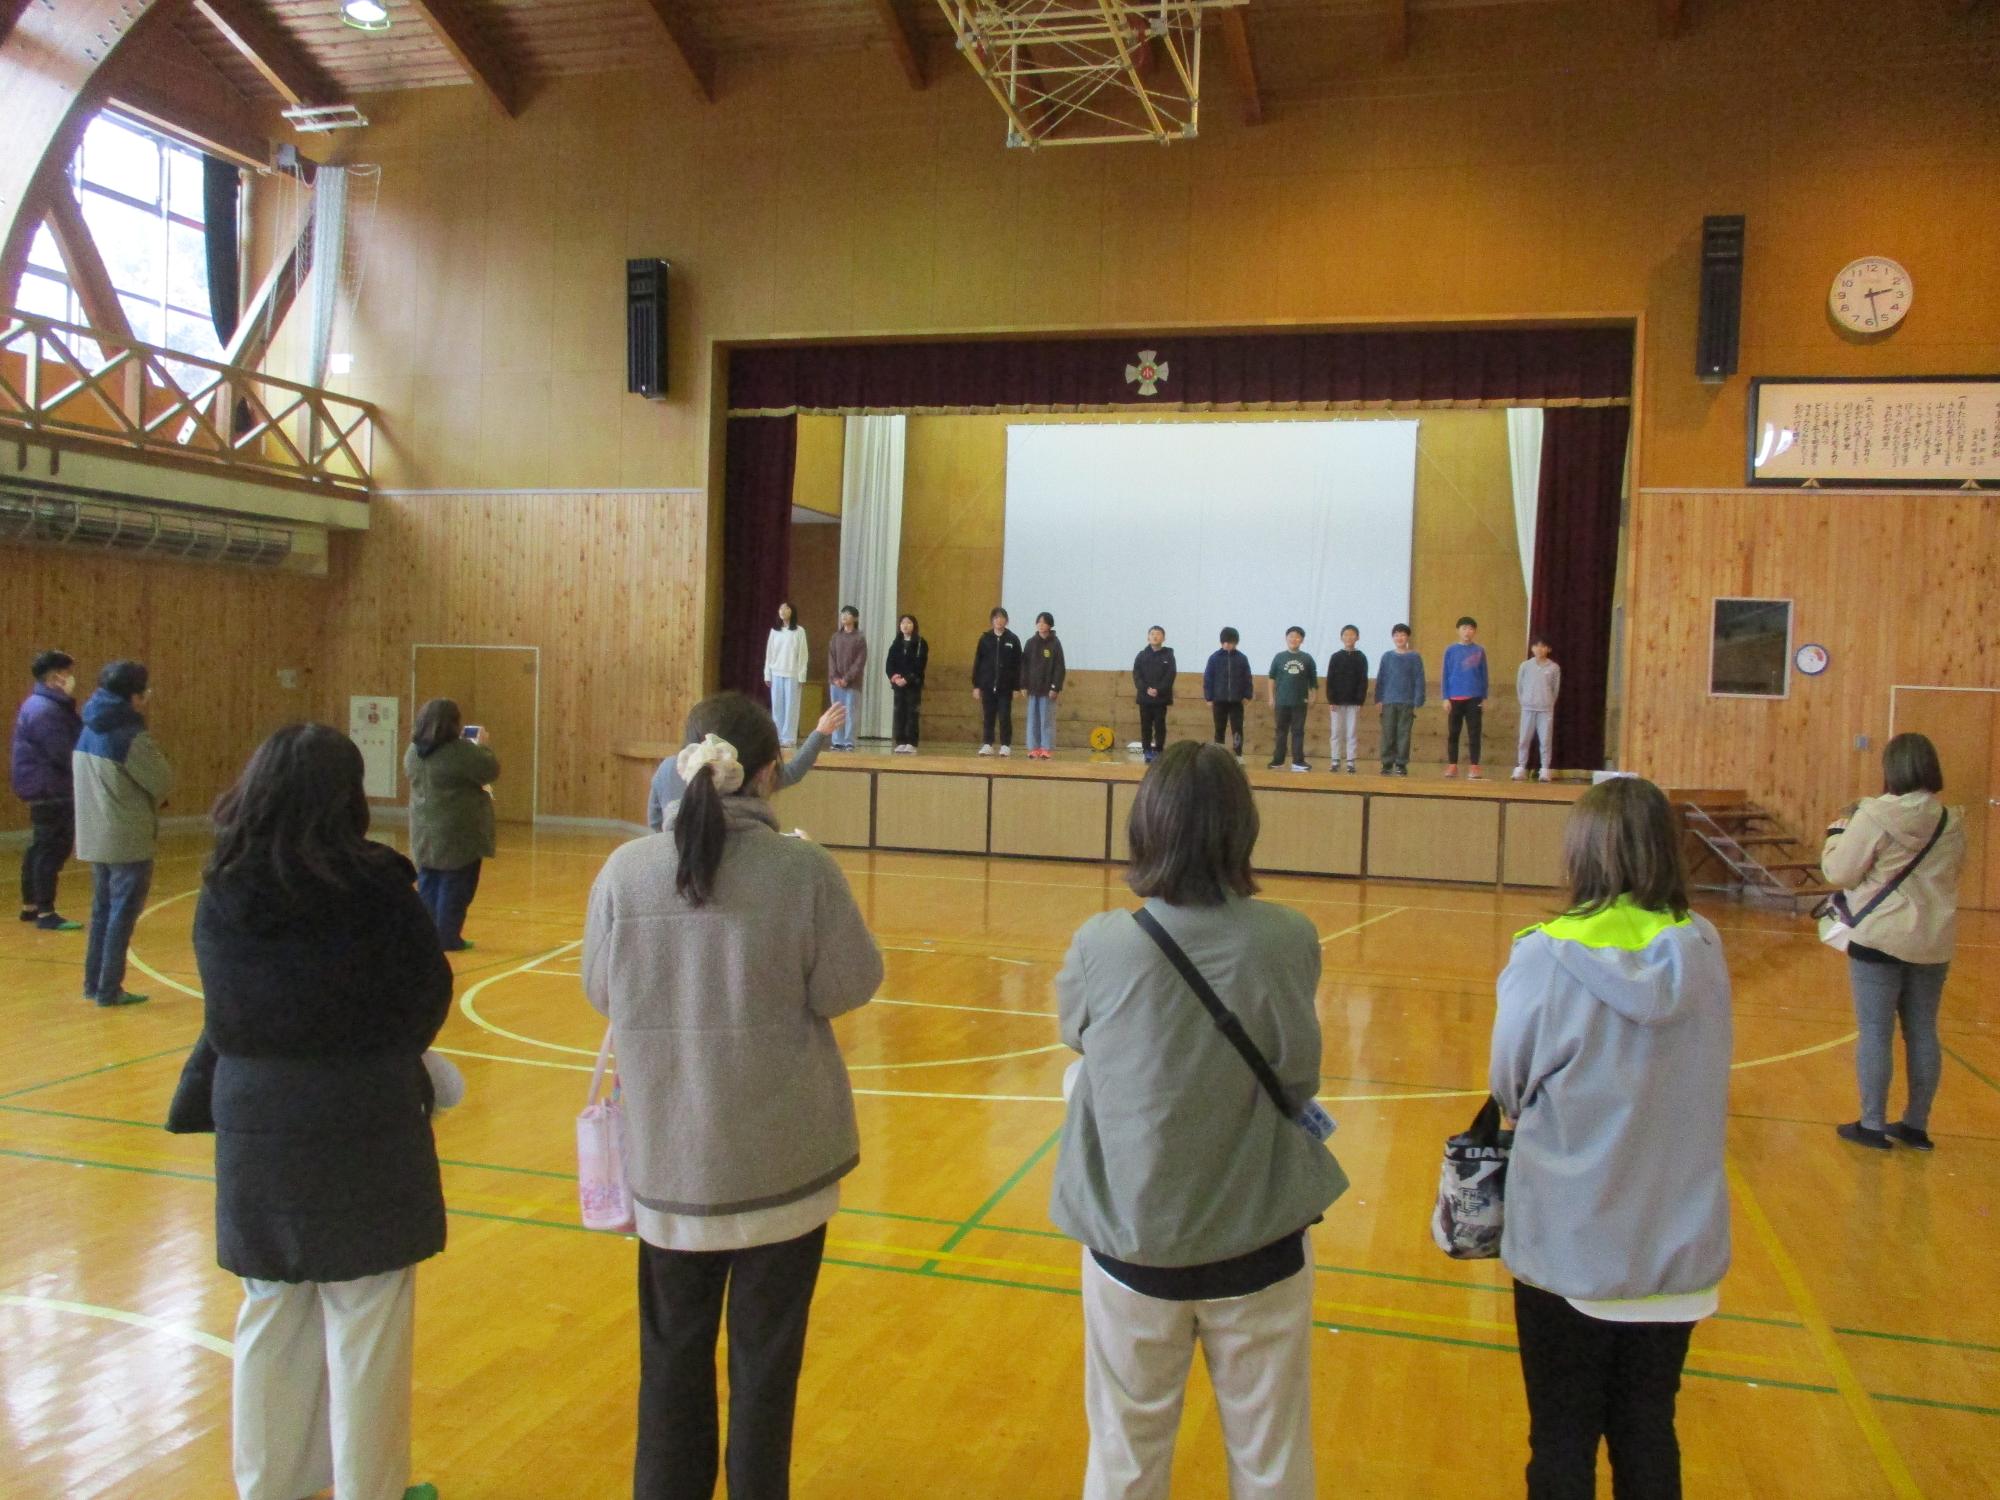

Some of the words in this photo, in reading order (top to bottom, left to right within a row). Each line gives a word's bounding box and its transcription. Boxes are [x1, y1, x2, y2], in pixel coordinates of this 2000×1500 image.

[1866, 264, 1878, 272] 12
[1892, 277, 1901, 285] 2
[1840, 304, 1849, 312] 8
[1881, 313, 1889, 321] 5
[1865, 318, 1874, 326] 6
